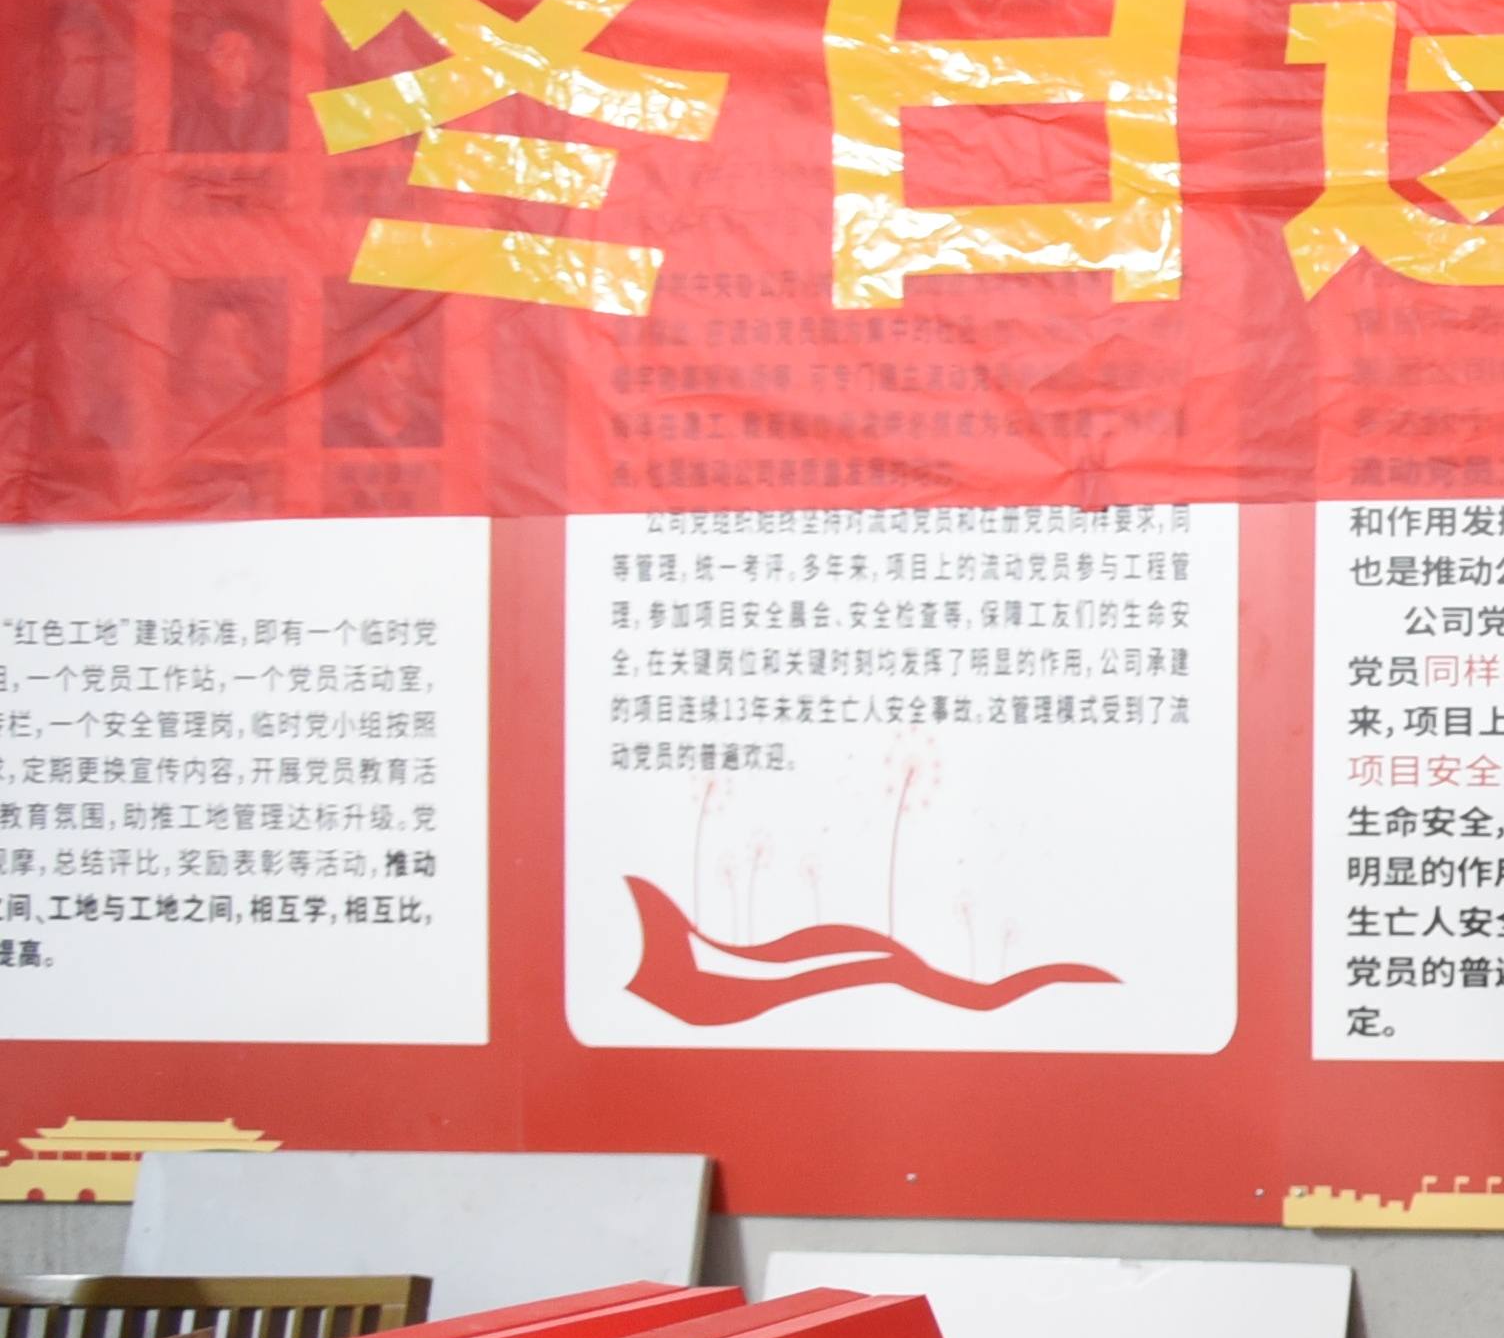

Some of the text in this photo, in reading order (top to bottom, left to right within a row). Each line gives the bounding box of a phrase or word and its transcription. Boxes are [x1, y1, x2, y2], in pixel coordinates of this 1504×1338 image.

[0, 710, 438, 740] 栏，一个安全管理岗，临时党小组按照
[0, 756, 438, 786] ，定期更换宣传内容，开展党员教育活
[0, 894, 435, 925] 间、工地与工地之间，相互学，相互比，
[1347, 1006, 1397, 1040] 定。
